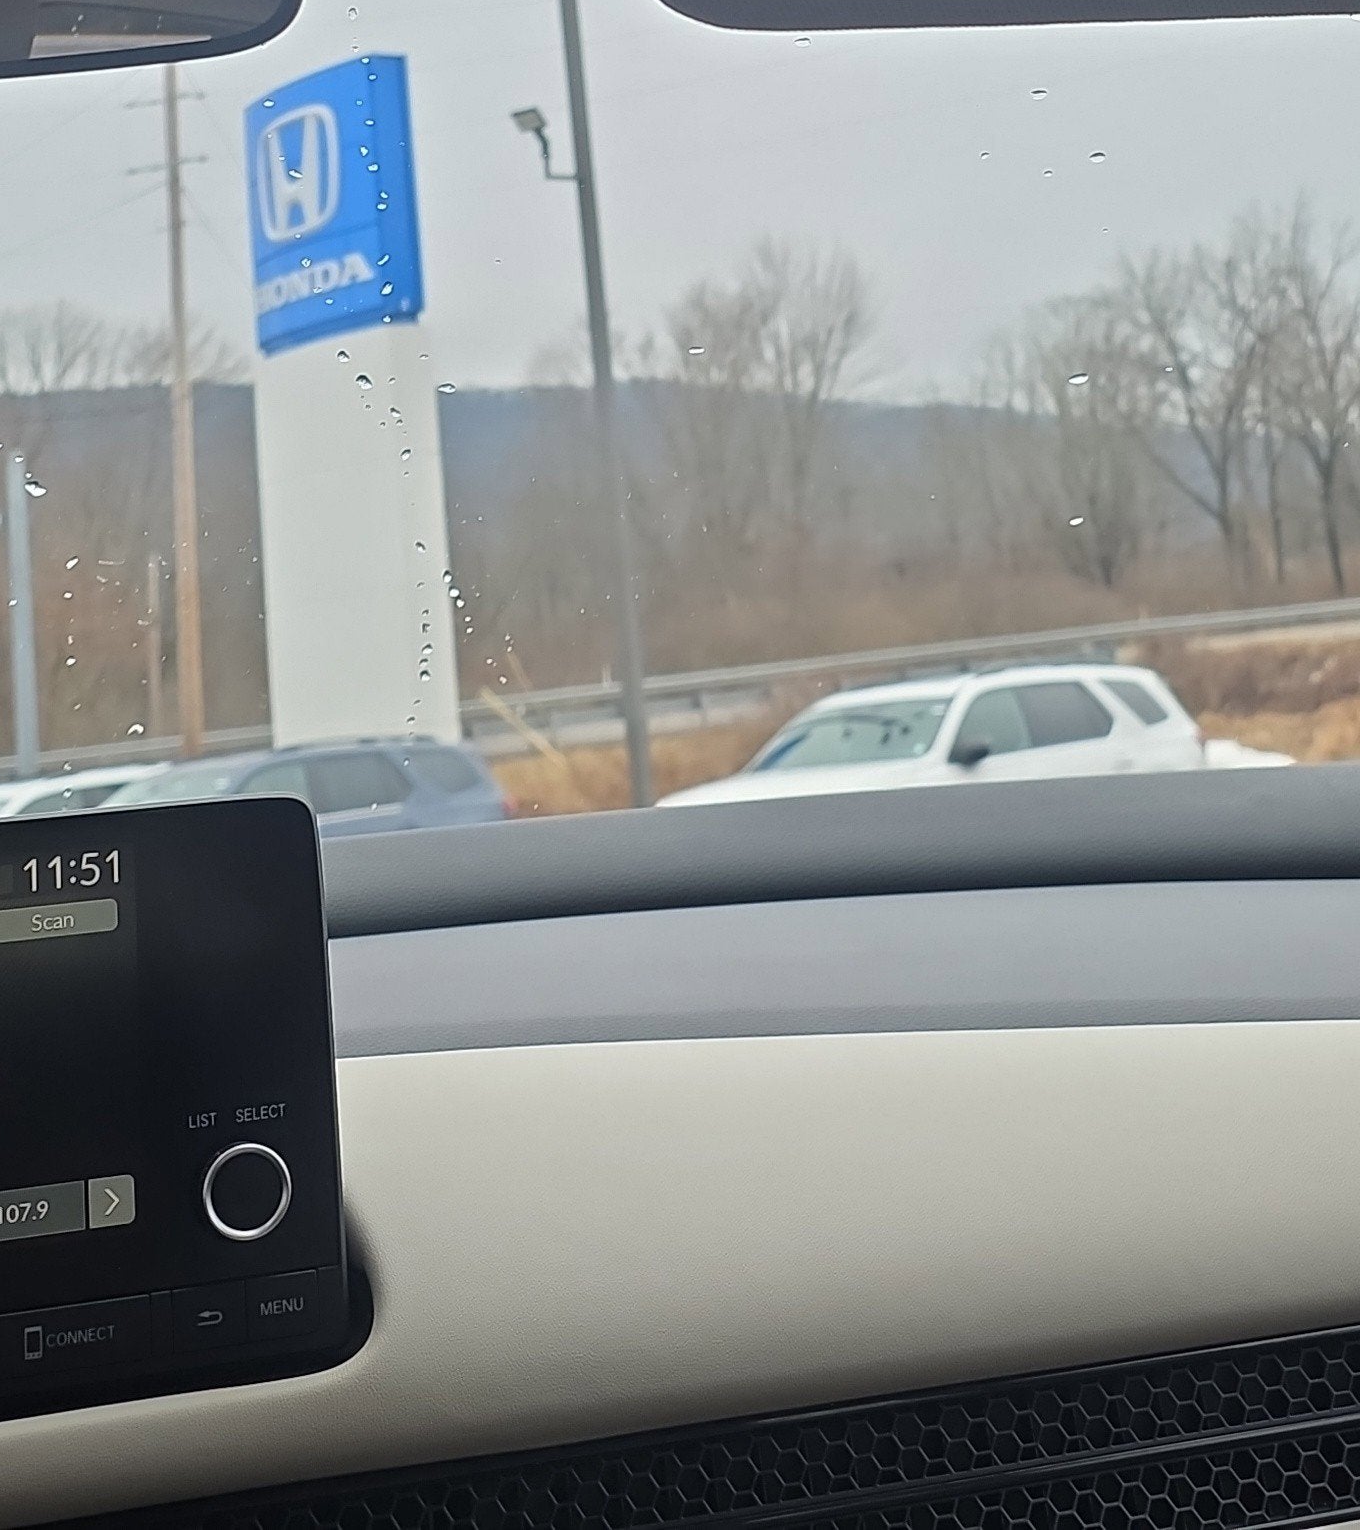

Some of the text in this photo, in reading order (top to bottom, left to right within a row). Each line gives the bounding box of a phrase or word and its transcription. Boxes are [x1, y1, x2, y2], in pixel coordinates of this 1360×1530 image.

[23, 849, 120, 893] 11:51
[30, 913, 75, 933] Scan
[188, 1103, 286, 1129] LIST SELECT
[259, 1297, 305, 1316] MENU
[46, 1325, 115, 1348] CONNECT
